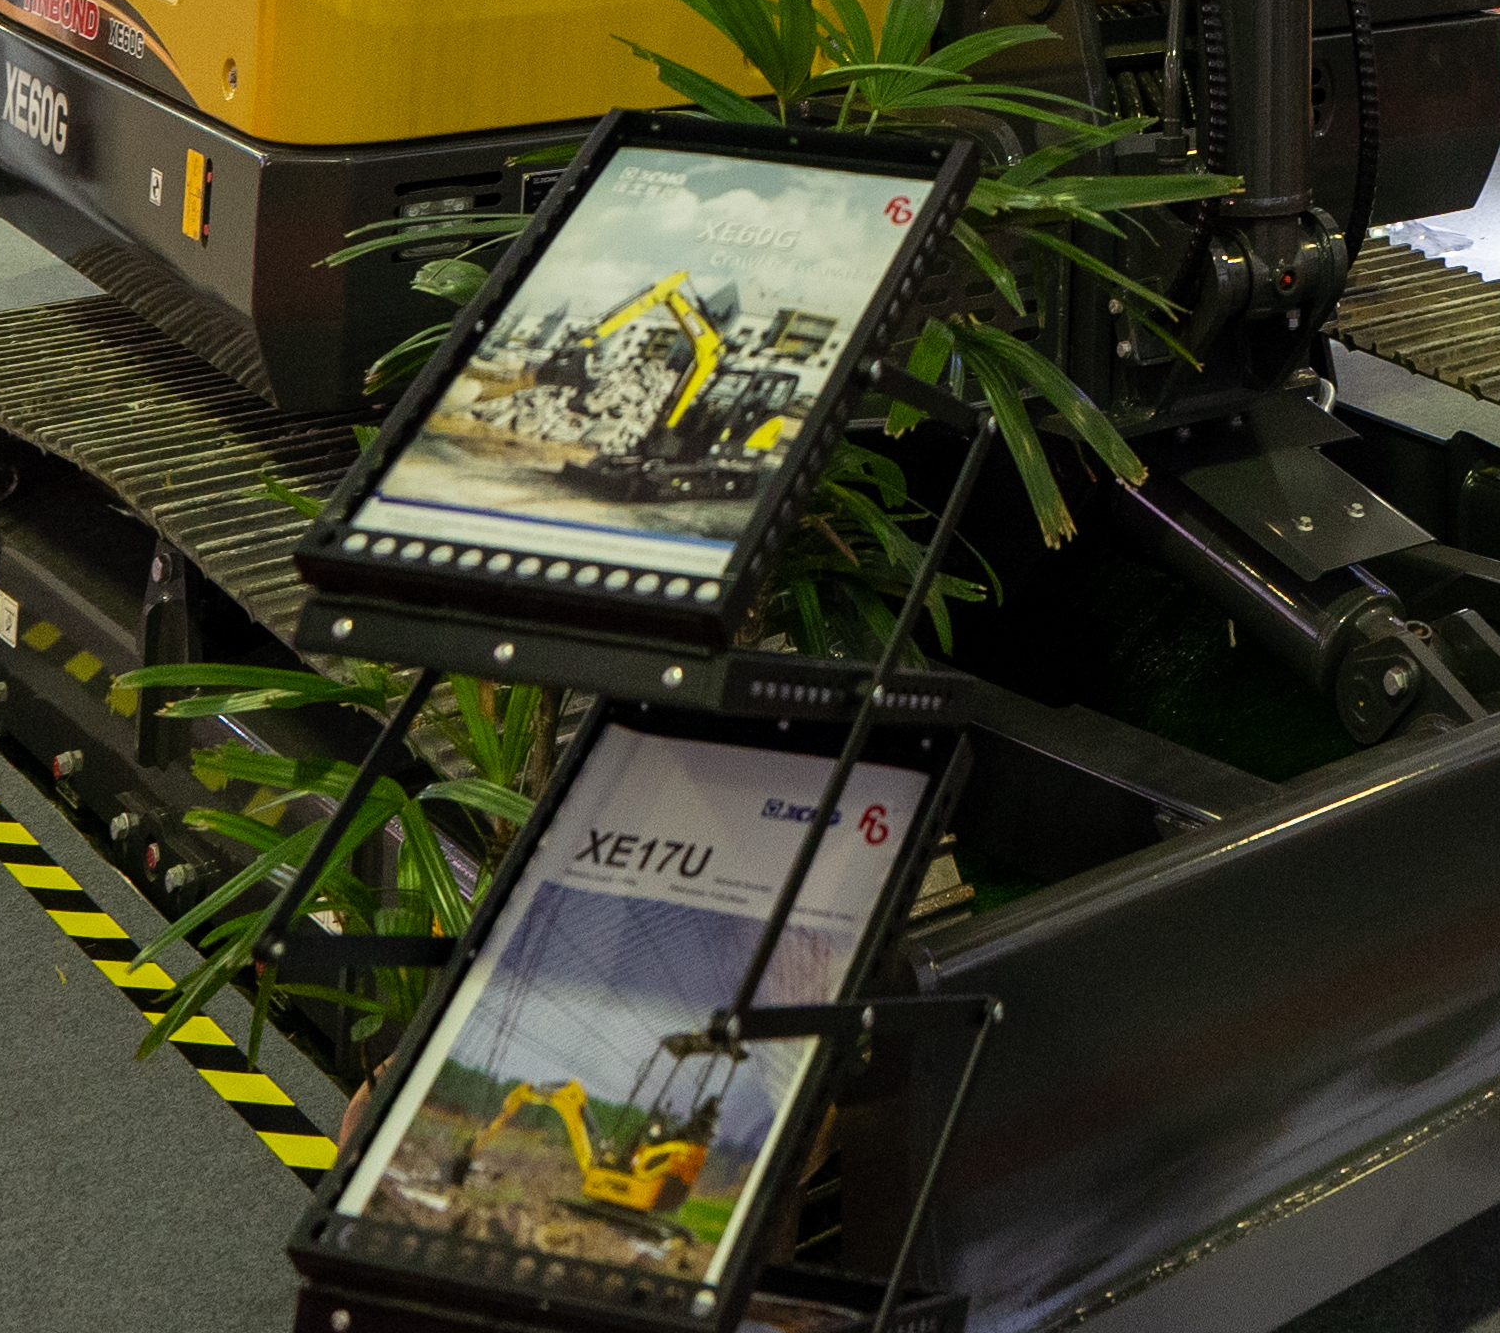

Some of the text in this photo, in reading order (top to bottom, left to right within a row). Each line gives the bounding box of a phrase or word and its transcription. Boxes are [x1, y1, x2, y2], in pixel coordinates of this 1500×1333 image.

[108, 17, 145, 59] XE60G
[2, 62, 69, 155] XE60G
[697, 220, 800, 251] XE60G
[574, 828, 714, 879] XE17U
